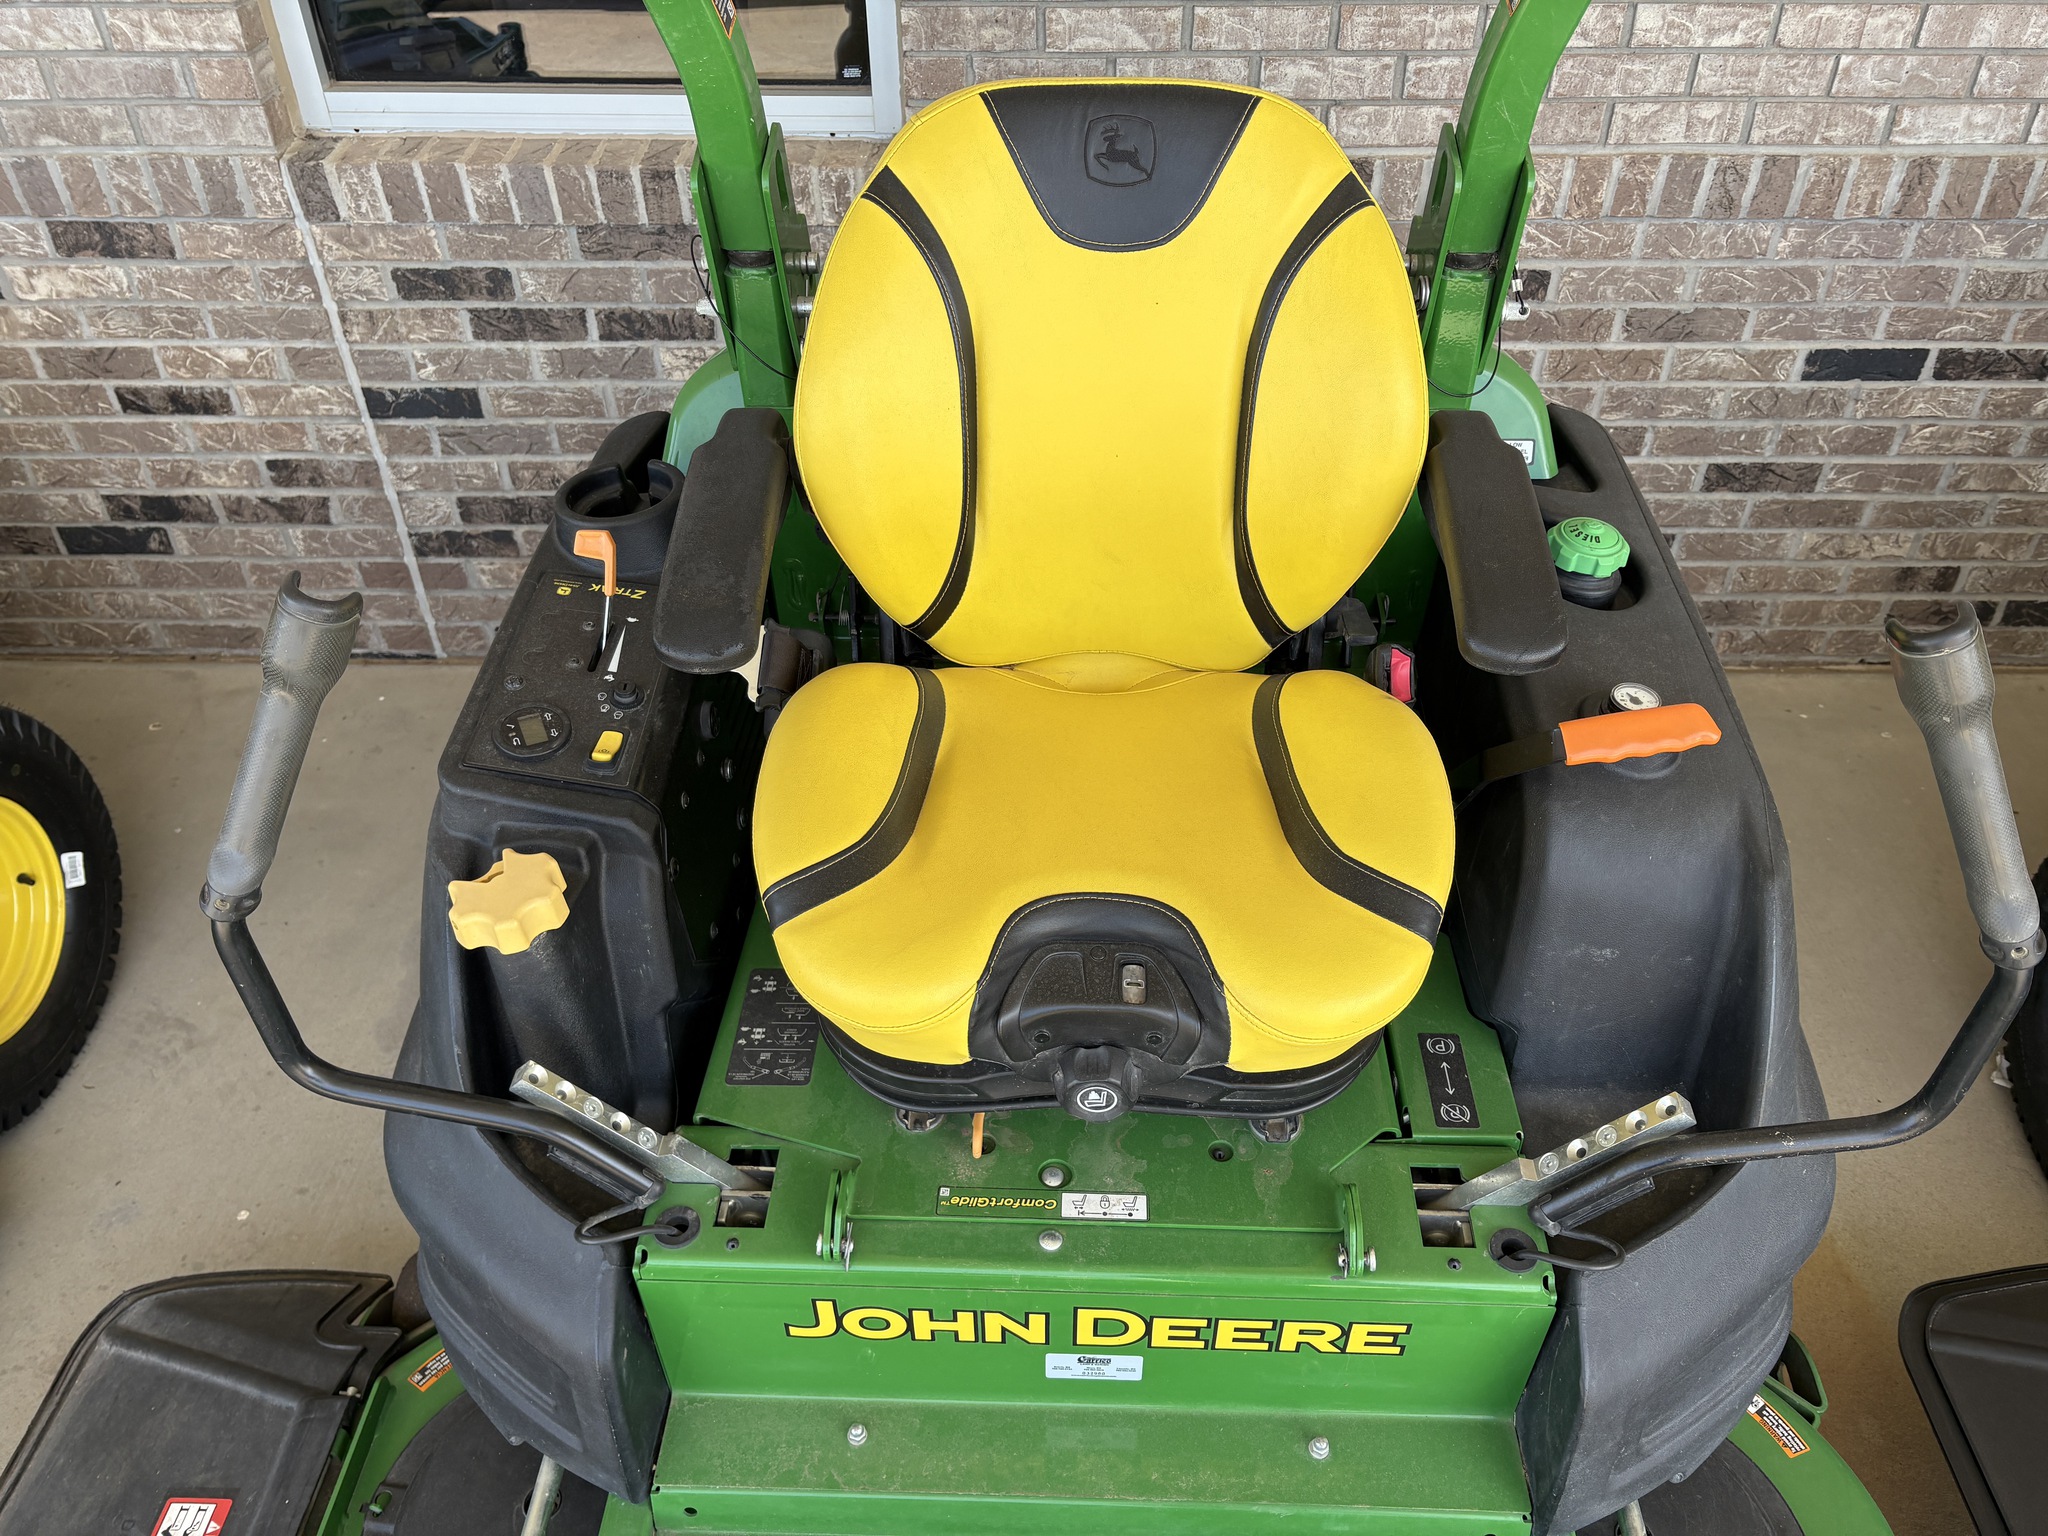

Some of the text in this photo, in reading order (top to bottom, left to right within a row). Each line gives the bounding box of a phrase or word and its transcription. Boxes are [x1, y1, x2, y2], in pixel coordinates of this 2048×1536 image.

[1568, 523, 1601, 544] DIESEL
[588, 583, 647, 600] ZTRK
[785, 1299, 1412, 1356] JOHN DEERE
[1759, 1419, 1782, 1443] WARNING
